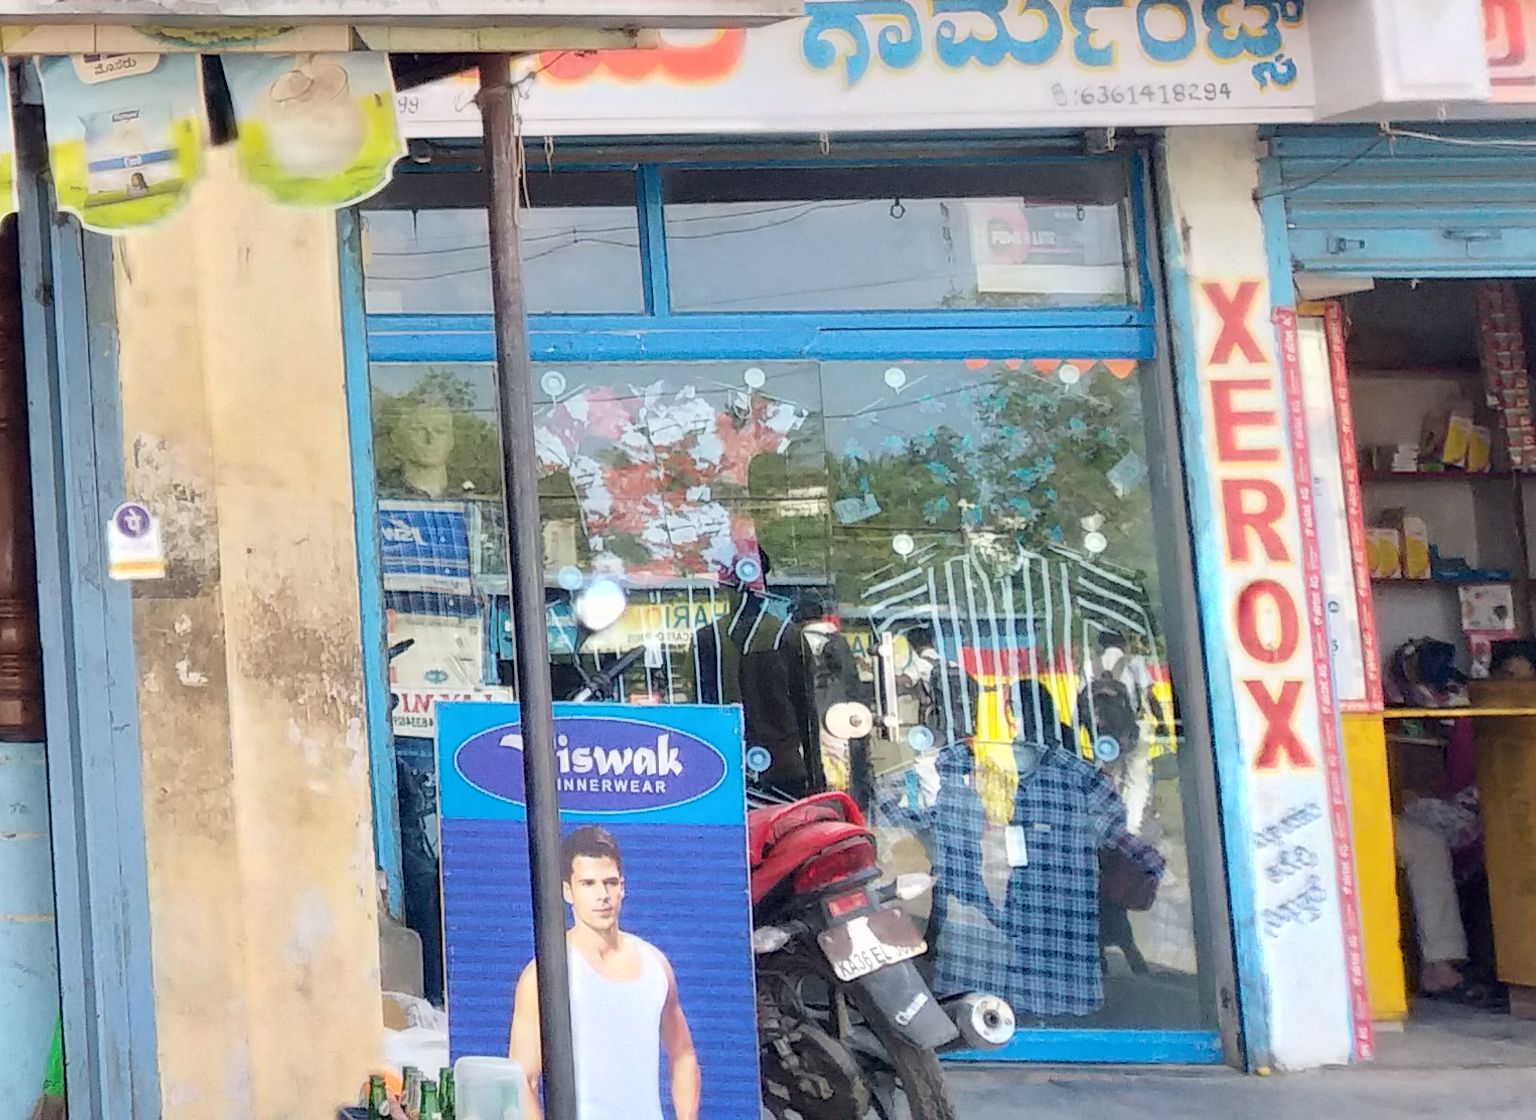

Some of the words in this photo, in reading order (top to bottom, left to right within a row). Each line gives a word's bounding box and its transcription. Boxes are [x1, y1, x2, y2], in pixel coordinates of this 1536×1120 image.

[1199, 279, 1315, 771] XEROX
[500, 731, 684, 777] iswak
[557, 779, 666, 794] INNERWEAR
